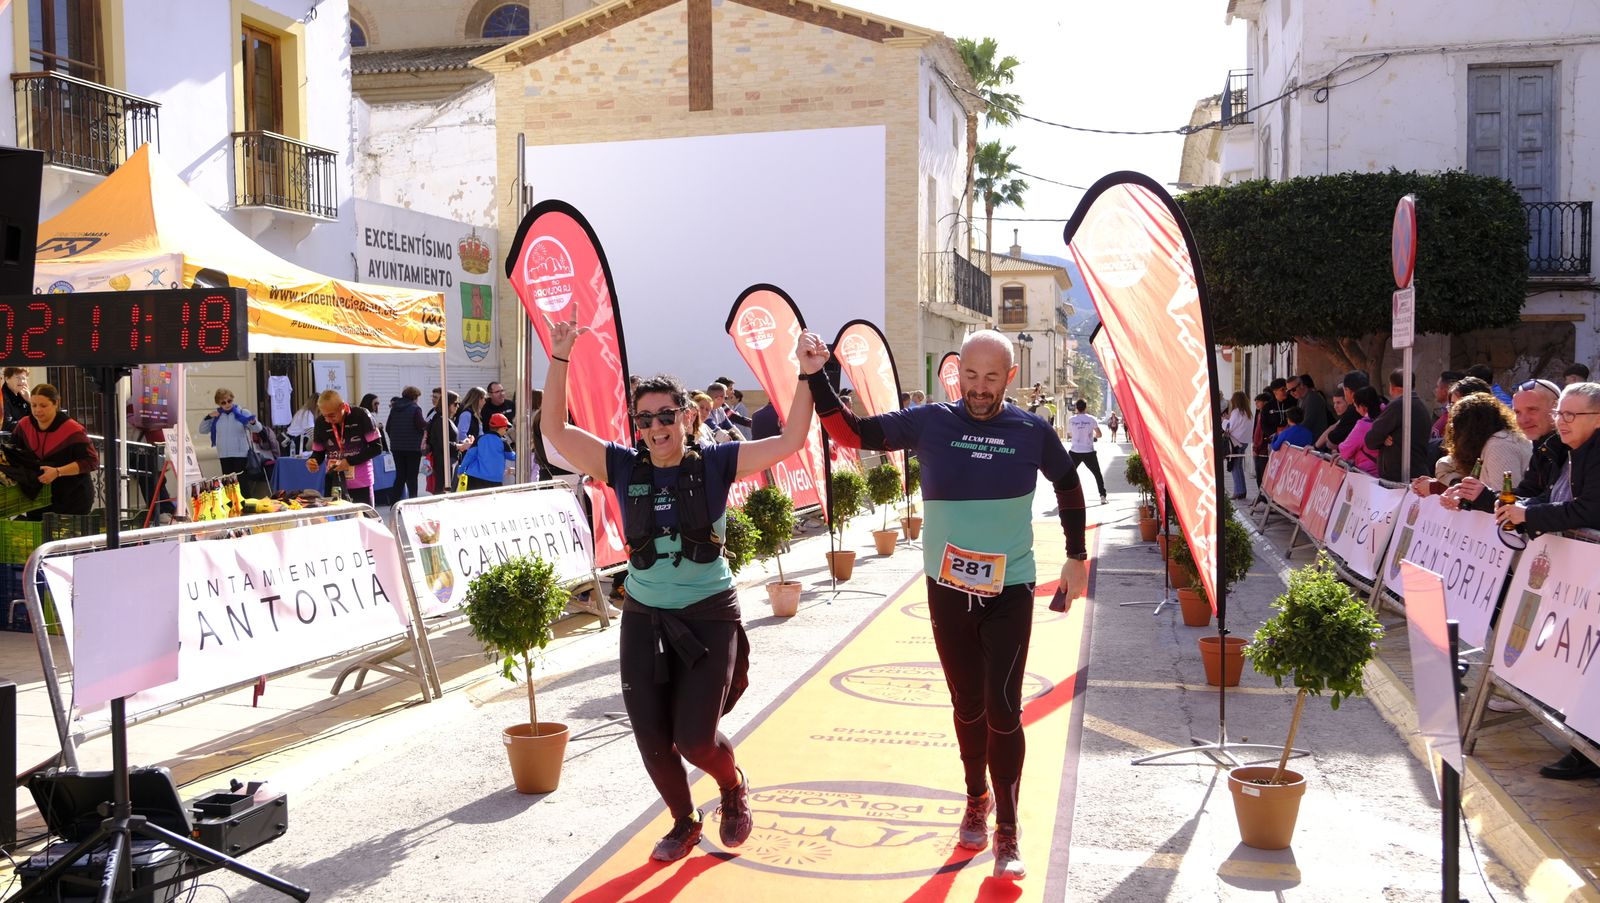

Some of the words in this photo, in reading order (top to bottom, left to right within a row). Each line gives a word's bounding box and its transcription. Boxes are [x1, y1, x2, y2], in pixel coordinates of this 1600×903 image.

[365, 228, 452, 260] EXCELENTÍSIMO
[368, 259, 453, 288] AYUNTAMIENTO
[950, 440, 977, 450] CIUDAD
[978, 444, 988, 452] DE
[985, 437, 1005, 445] TRAIL
[971, 451, 993, 460] 2023
[453, 514, 555, 542] AYUNTAMIENTO
[558, 511, 575, 524] DE
[458, 527, 584, 577] CANTORIA
[1489, 547, 1504, 568] DE
[187, 555, 345, 601] UNTAMIENTO
[353, 549, 376, 568] DE
[952, 557, 992, 578] 281
[196, 573, 390, 651] ANTORIA
[1535, 611, 1600, 676] CAN
[832, 727, 947, 739] Cantoria
[752, 793, 924, 813] POLVORA
[777, 788, 862, 800] Cantoria
